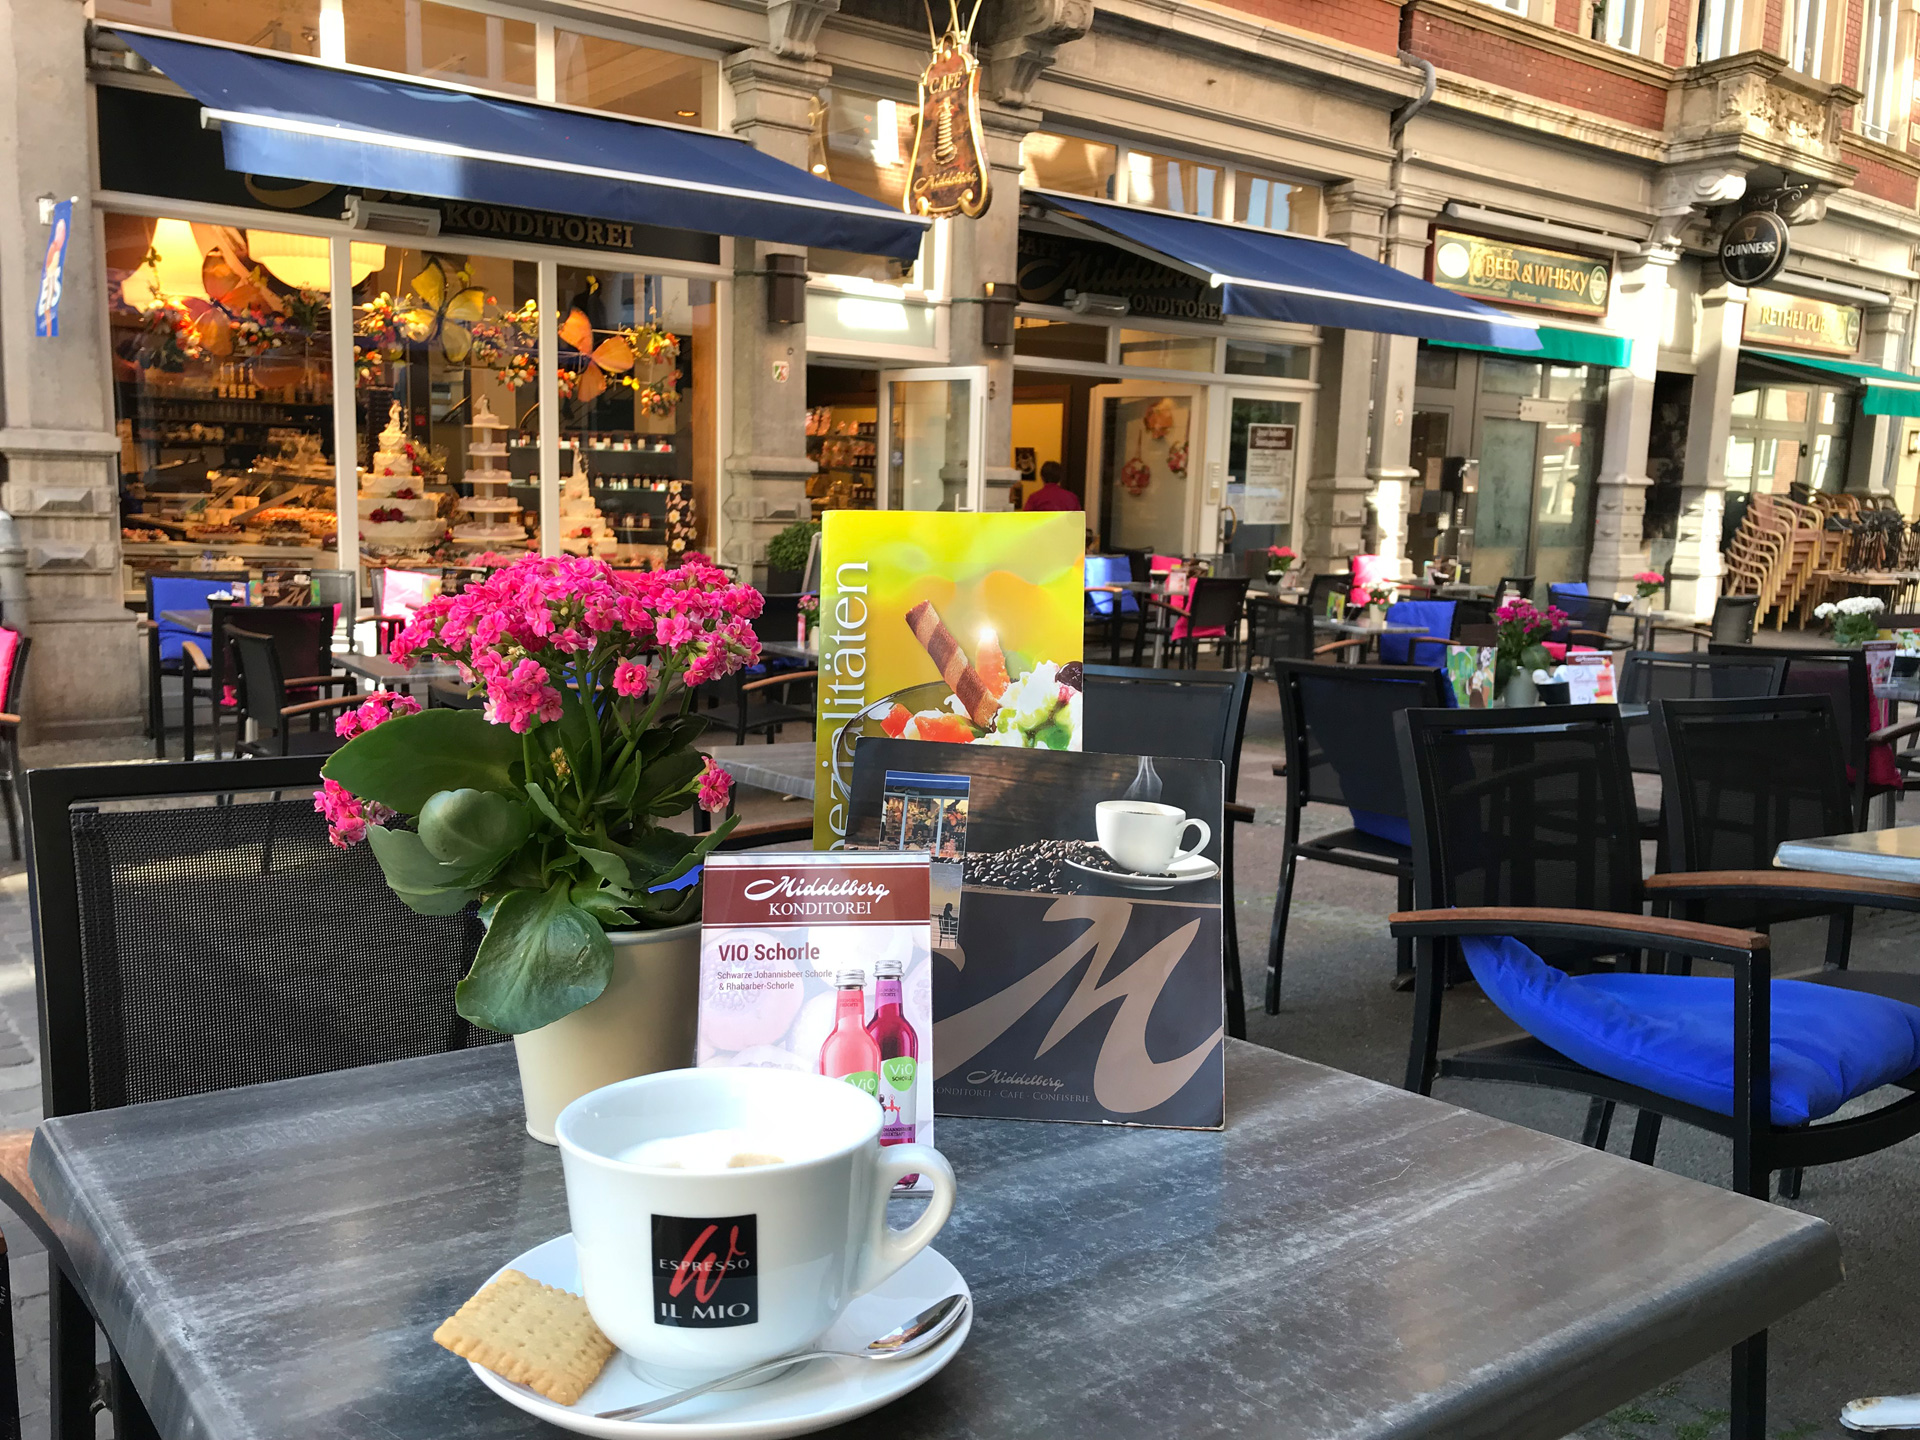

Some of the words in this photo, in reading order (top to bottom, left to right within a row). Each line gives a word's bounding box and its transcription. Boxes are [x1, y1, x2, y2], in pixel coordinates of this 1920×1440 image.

[443, 202, 634, 249] KONDITOREI
[1724, 241, 1776, 257] GUINNESS
[1485, 255, 1521, 283] BEER
[1521, 264, 1533, 284] &
[1534, 265, 1589, 296] WHISKY
[1123, 293, 1223, 320] ONDITOREI
[1761, 306, 1804, 330] RETHEL
[744, 875, 890, 903] Middelberg
[769, 902, 872, 916] KONDITOREI
[718, 944, 749, 961] VIO
[754, 942, 820, 960] Schorle
[717, 971, 753, 979] Schwarze
[754, 970, 803, 979] Johannisbeer
[805, 969, 832, 978] Schorle
[726, 981, 794, 990] Rhabarber-Schorle
[889, 1063, 914, 1076] ViO
[967, 1070, 1065, 1091] Middelberg
[933, 1086, 991, 1098] ONDITOREI
[659, 1258, 750, 1272] ESPRESSO
[661, 1302, 682, 1319] IL
[692, 1302, 750, 1319] MIO
